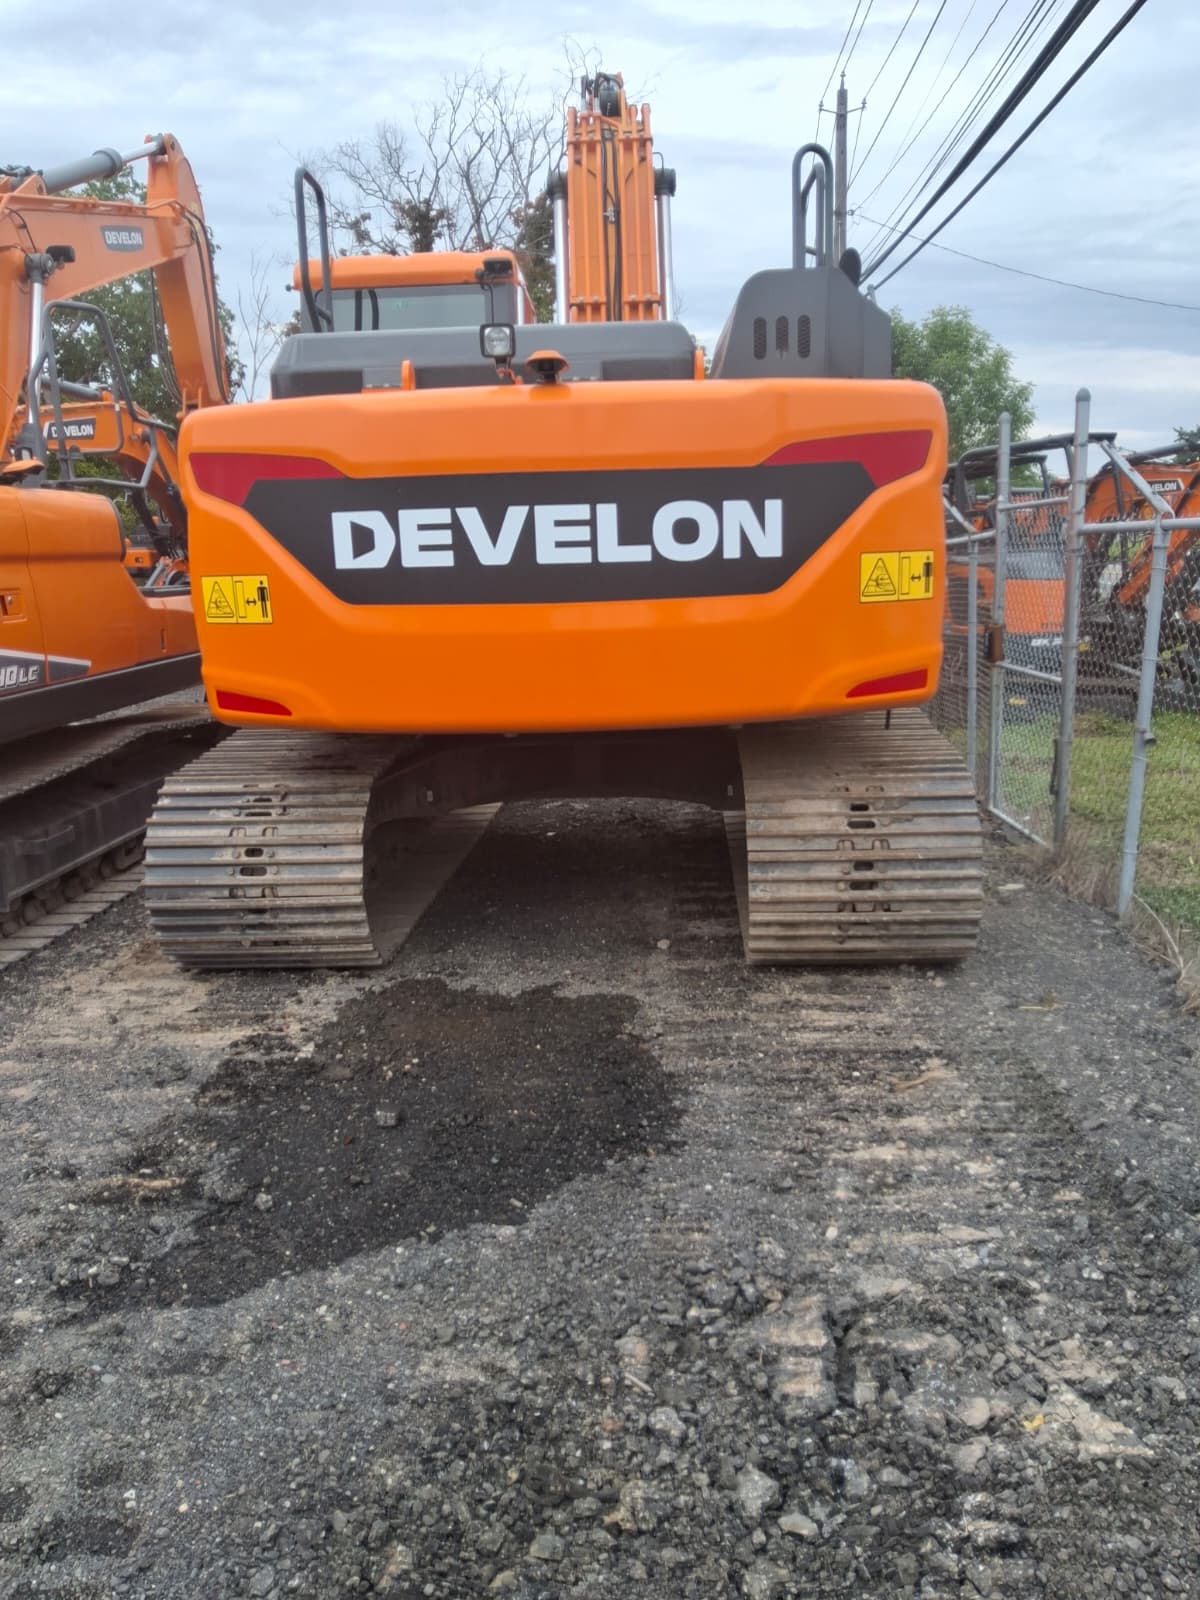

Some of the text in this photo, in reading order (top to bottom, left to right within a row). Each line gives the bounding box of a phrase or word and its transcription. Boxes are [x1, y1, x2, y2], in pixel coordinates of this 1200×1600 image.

[104, 231, 143, 245] DEVELON
[51, 423, 94, 438] DVELON
[331, 499, 783, 570] DEVELON
